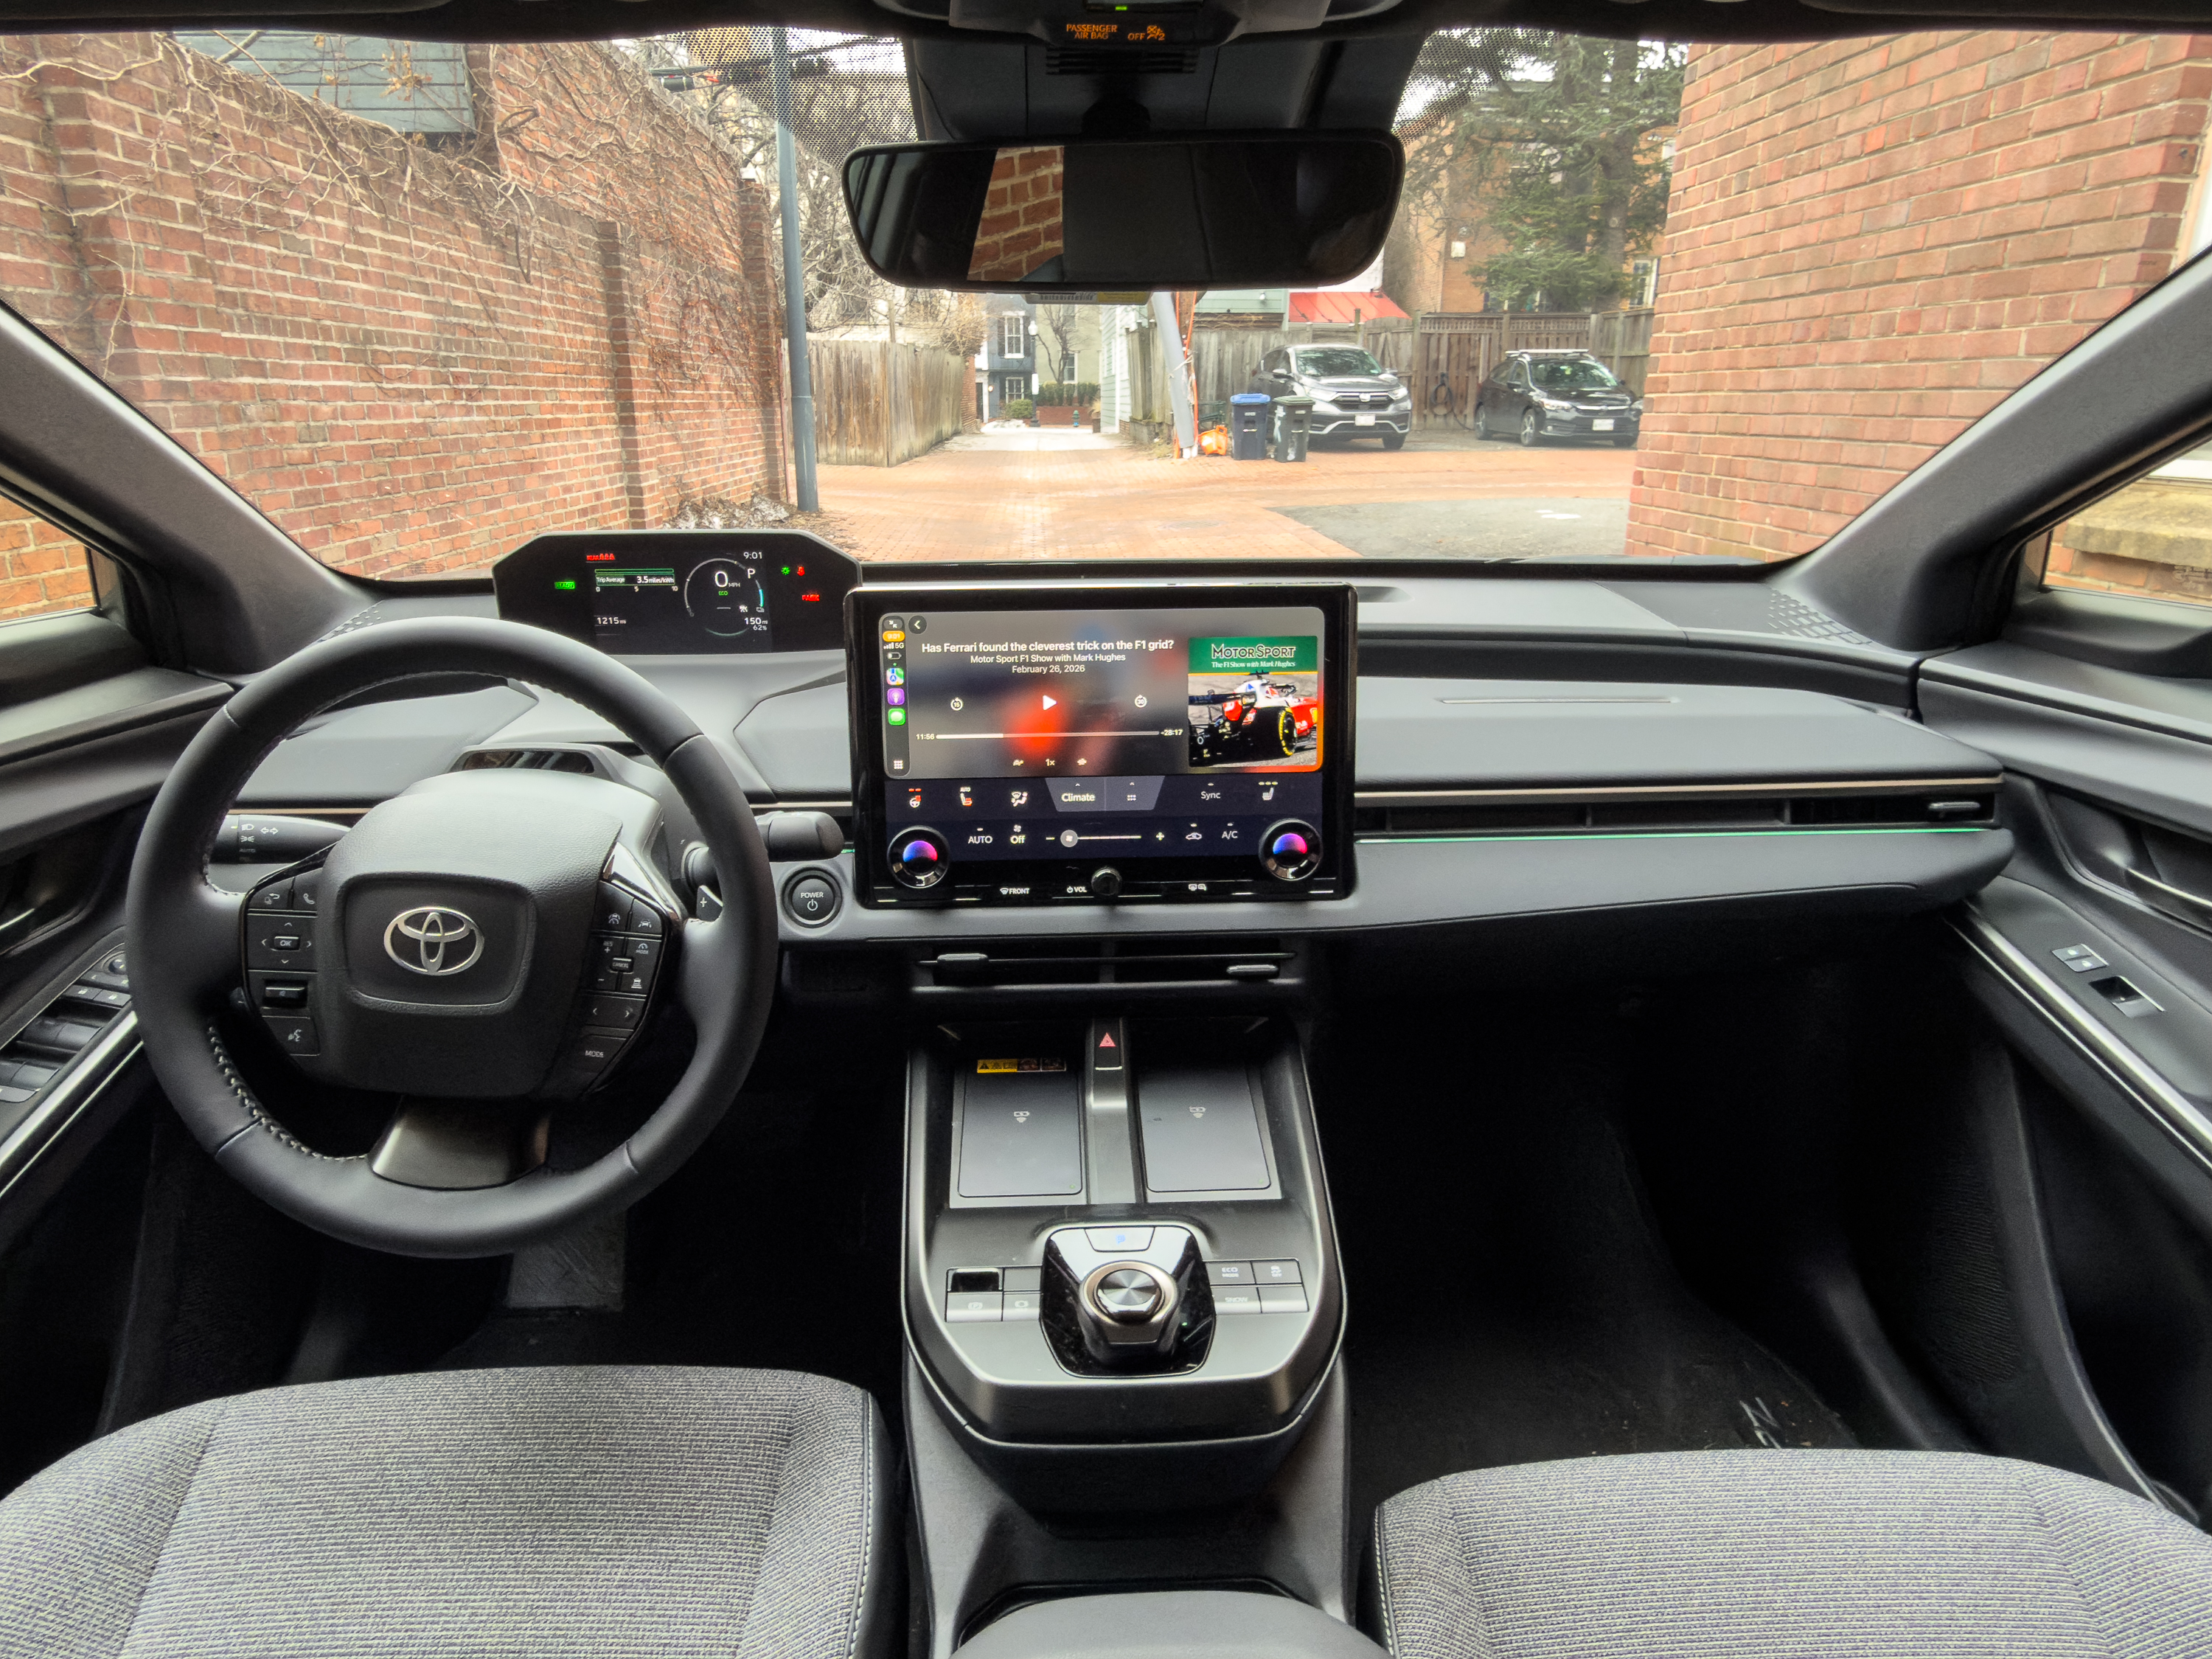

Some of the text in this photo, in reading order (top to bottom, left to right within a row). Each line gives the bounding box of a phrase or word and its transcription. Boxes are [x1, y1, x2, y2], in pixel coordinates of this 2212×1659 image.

[1066, 24, 1118, 32] PASSENGER
[747, 568, 756, 579] P
[714, 571, 728, 588] 0
[922, 644, 942, 653] Has
[944, 642, 977, 652] Ferrari
[979, 642, 1009, 652] found
[1010, 642, 1027, 651] the
[1029, 641, 1074, 651] cleverest
[1077, 640, 1099, 650] trick
[1116, 640, 1133, 650] the
[1135, 640, 1145, 650] F1
[1148, 639, 1175, 651] grid?
[970, 655, 995, 664] Motor
[995, 655, 1018, 664] Sport
[1030, 655, 1053, 663] Show
[1054, 654, 1071, 662] with
[1095, 653, 1126, 663] Hughes
[1012, 665, 1047, 675] February
[1048, 665, 1062, 674] 26,
[1061, 793, 1096, 801] Climate
[1200, 791, 1220, 800] Sync
[968, 835, 992, 844] AUTO
[1010, 835, 1026, 844] Off
[1222, 831, 1238, 840] A/C
